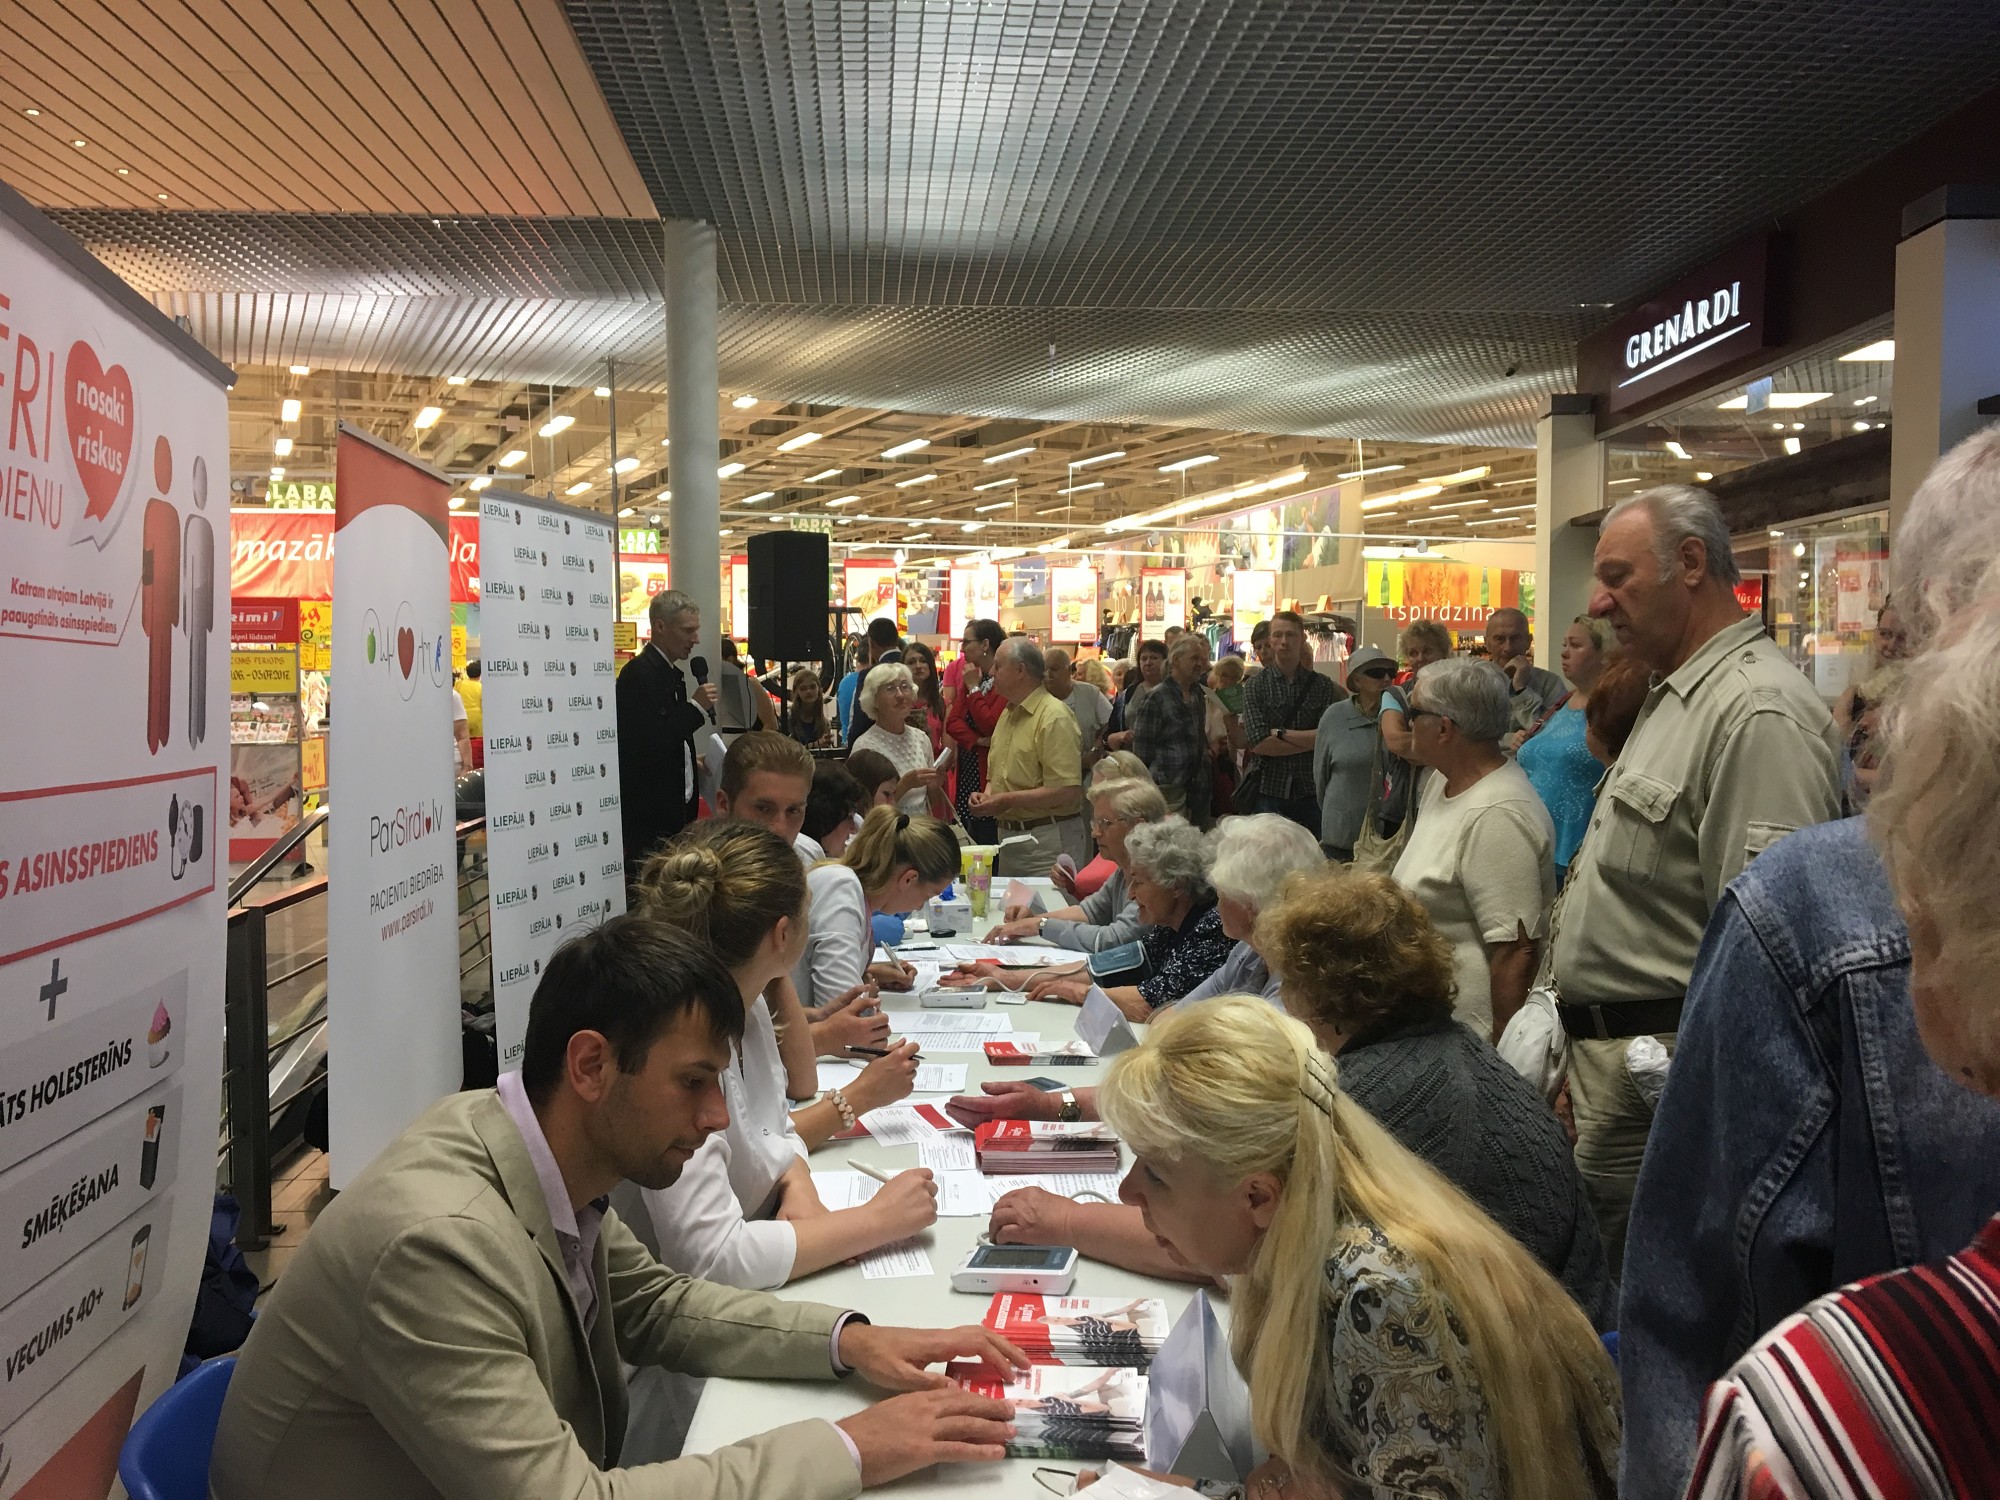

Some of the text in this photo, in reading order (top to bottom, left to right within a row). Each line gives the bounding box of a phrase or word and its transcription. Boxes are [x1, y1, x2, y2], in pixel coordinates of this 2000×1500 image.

[1626, 281, 1740, 369] GRENARDI
[77, 379, 125, 427] nosaki
[77, 426, 122, 475] riskus
[0, 465, 63, 530] IENU
[272, 483, 334, 501] LABA
[484, 503, 510, 518] LIEPĀJA
[538, 514, 559, 528] LIEPĀJA
[514, 546, 537, 560] LIEPĀJA
[562, 555, 585, 567] LIEPĀJA
[11, 577, 114, 612] Katram otrajam Latvijā ir
[486, 581, 515, 595] LIEPĀJA
[541, 587, 562, 600] LIEPĀJA
[1376, 600, 1495, 622] tspirdzina
[1, 609, 117, 635] paaugstināts asinsspiediens
[518, 621, 540, 635] LIEPĀJA
[565, 625, 589, 637] LIEPĀJA
[487, 658, 518, 672] LIEPĀJA
[544, 659, 565, 672] LIEPĀJA
[522, 696, 543, 709] LIEPĀJA
[568, 694, 592, 707] LIEPĀJA
[490, 735, 522, 749] LIEPĀJA
[547, 731, 569, 744] LIEPĀJA
[525, 770, 546, 784] LIEPĀJA
[572, 763, 595, 777] LIEPĀJA
[550, 802, 572, 817] LIEPĀJA
[493, 812, 525, 828] LIEPĀJA
[574, 833, 598, 848] LIEPĀJA
[528, 844, 549, 859] LIEPĀJA
[13, 829, 159, 896] ASINSSPIEDIENS
[553, 873, 575, 889] LIEPĀJA
[370, 863, 444, 916] PACIENTU BIEDRĪBA
[496, 887, 528, 905] LIEPĀJA
[577, 900, 600, 918] LIEPĀJA
[381, 898, 434, 942] www.parsirdi.lv
[530, 916, 552, 935] LIEPĀJA
[500, 963, 530, 983] LIEPĀJA
[504, 1040, 525, 1060] LIEPĀ
[30, 1038, 132, 1114] HOLESTERĪNS
[21, 1163, 119, 1249] SMĒĶĒŠANA
[6, 1286, 104, 1383] VECUMS 40+
